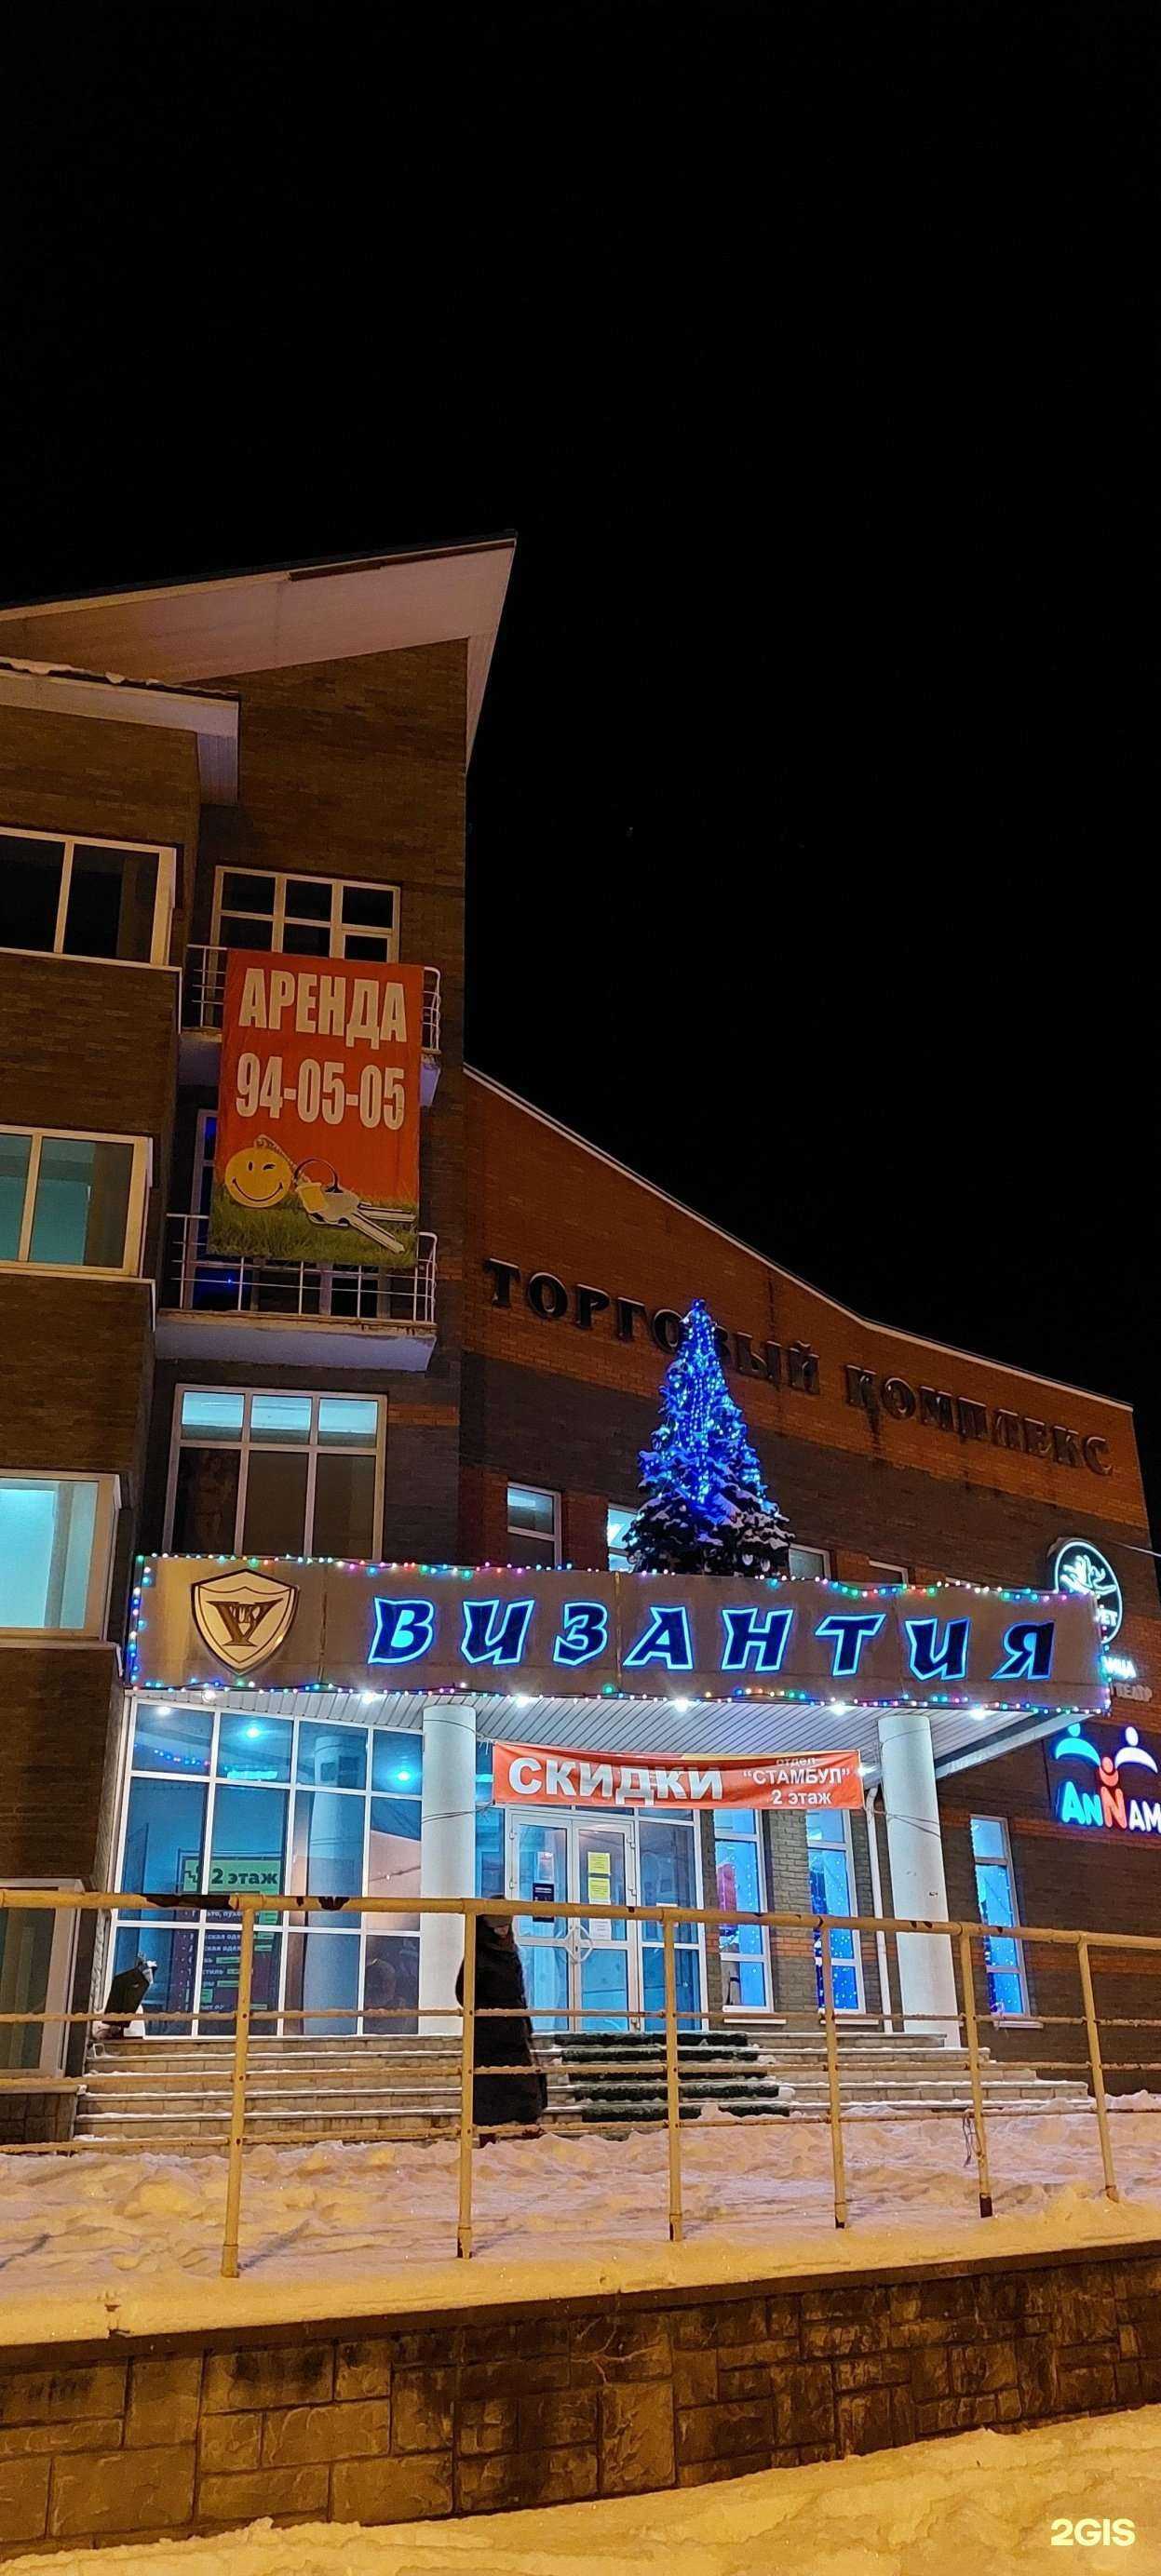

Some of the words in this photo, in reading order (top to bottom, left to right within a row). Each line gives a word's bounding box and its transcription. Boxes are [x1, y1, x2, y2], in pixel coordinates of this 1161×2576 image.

[238, 967, 408, 1051] АРЕНДА
[236, 1052, 406, 1131] 94-05-05
[843, 1363, 1114, 1477] КОМПЛЕКС
[367, 1596, 1056, 1683] ВИЗАНТИЯ
[507, 1756, 723, 1807] СКИДКИ
[772, 1789, 784, 1806] 2
[788, 1791, 834, 1805] этаж
[211, 1868, 223, 1885] 2
[227, 1872, 278, 1885] этаж
